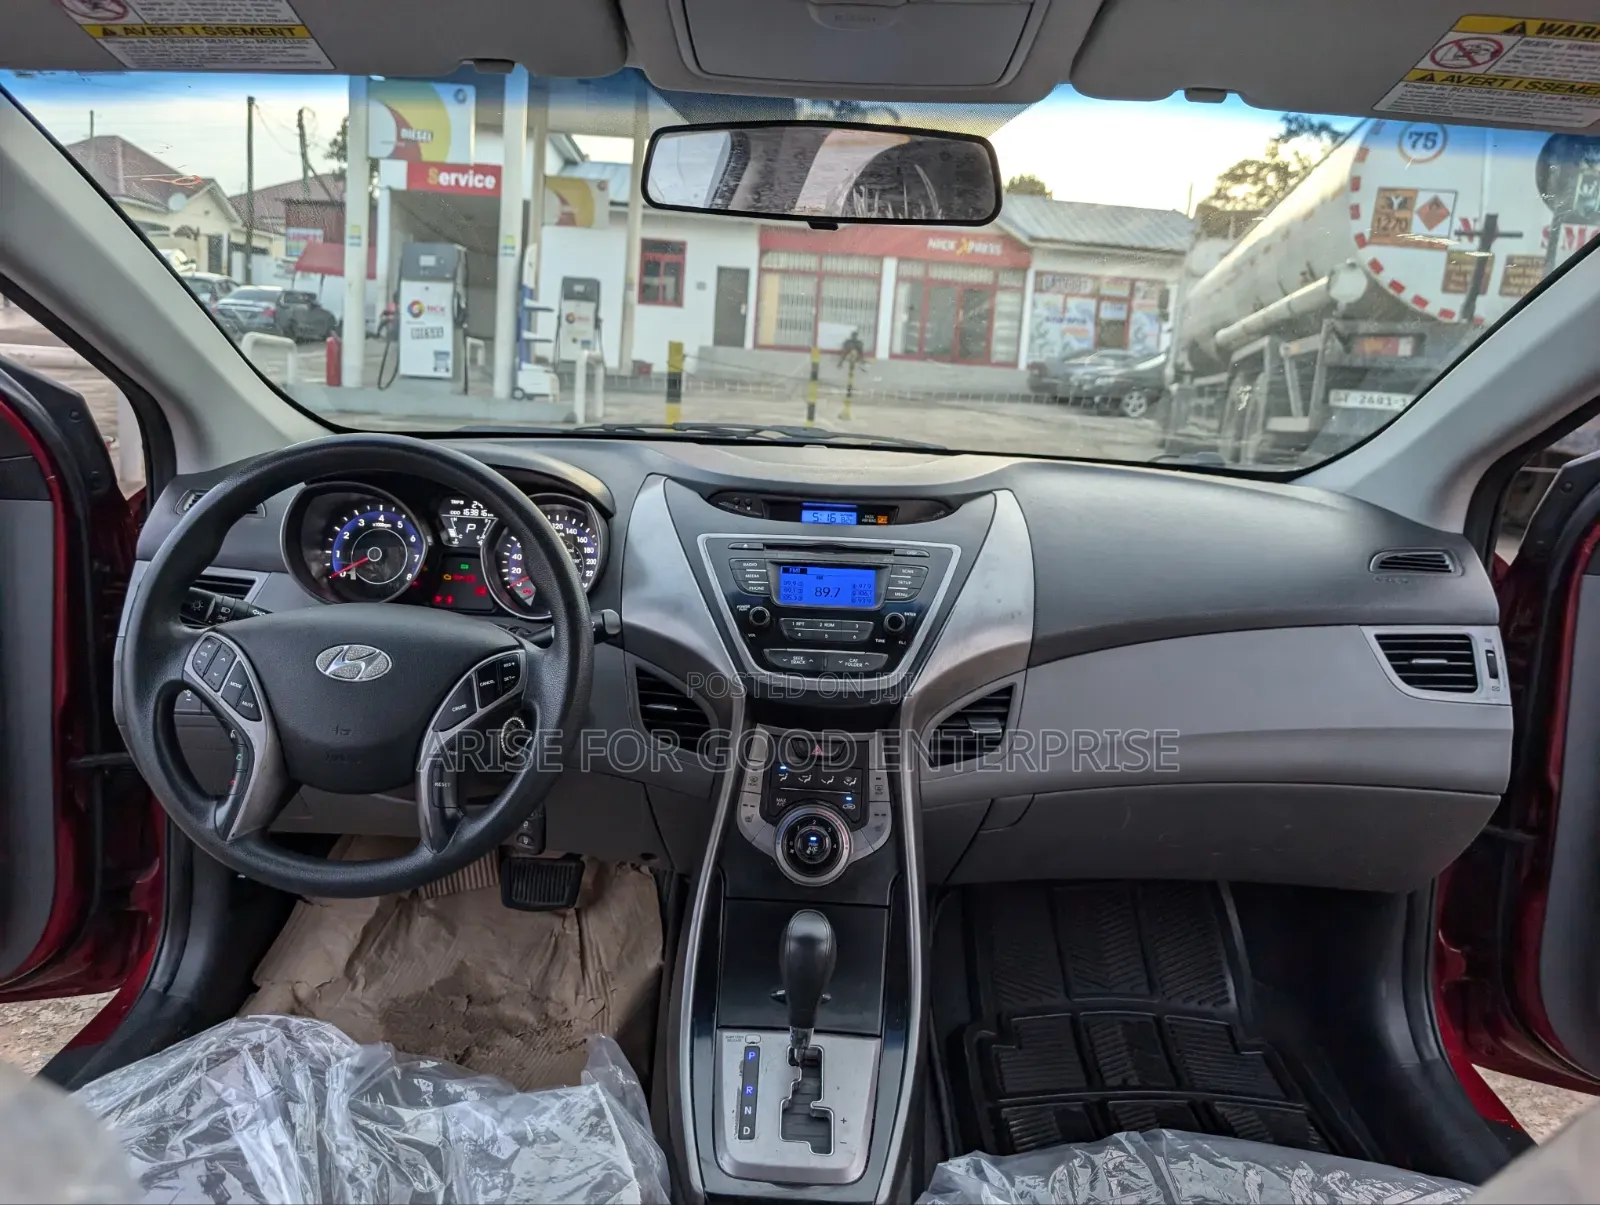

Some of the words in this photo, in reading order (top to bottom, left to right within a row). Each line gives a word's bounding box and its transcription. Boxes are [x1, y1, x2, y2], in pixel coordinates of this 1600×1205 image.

[1408, 131, 1438, 150] 75
[427, 166, 496, 189] Service
[379, 514, 385, 522] 4
[812, 512, 837, 524] 5:16
[358, 519, 365, 527] 3
[397, 521, 404, 529] 5
[465, 523, 477, 534] P
[566, 527, 578, 535] 140
[343, 532, 350, 540] 2
[577, 536, 588, 544] 160
[336, 550, 340, 558] 1
[512, 553, 523, 561] 40
[406, 573, 413, 581] 8
[814, 586, 841, 598] 89.7
[230, 681, 243, 689] MODE
[748, 1051, 756, 1060] P
[746, 1086, 753, 1094] R
[744, 1106, 752, 1115] N
[743, 1126, 750, 1135] D
